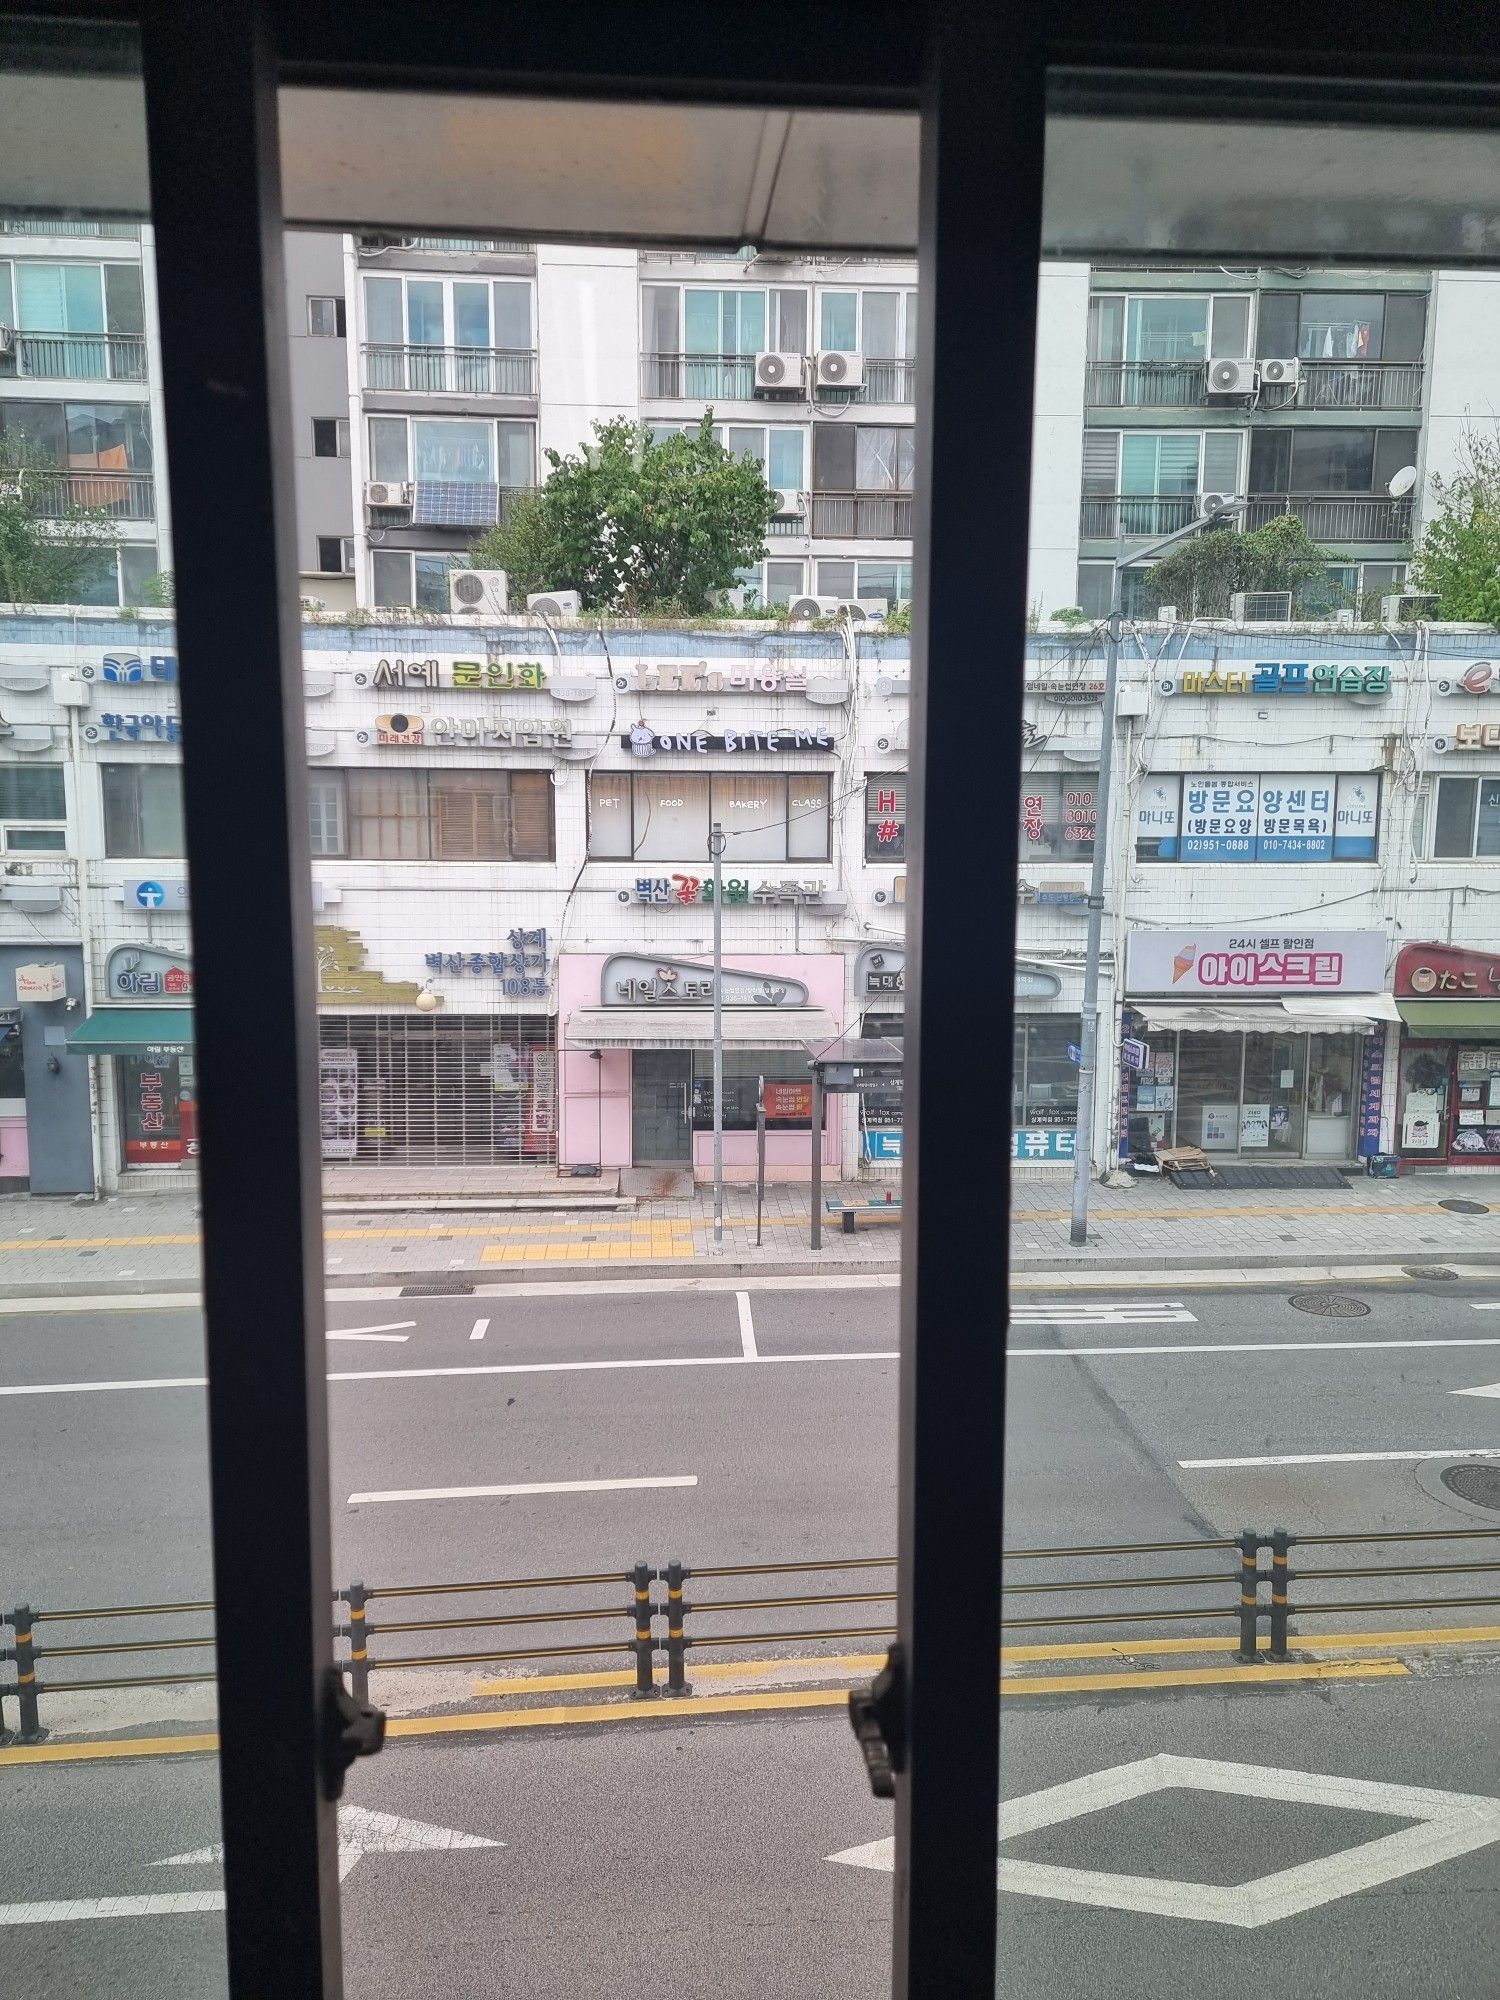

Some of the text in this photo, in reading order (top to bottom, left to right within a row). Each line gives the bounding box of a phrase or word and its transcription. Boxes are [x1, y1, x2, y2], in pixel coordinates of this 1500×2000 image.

[373, 659, 547, 689] 서예 문인화
[1183, 663, 1391, 694] 마스터 골프 연습장
[659, 727, 829, 753] ONE BITE ME
[599, 798, 620, 808] PET
[660, 799, 684, 808] FOOD
[729, 798, 768, 810] BAKERY
[791, 799, 822, 808] CLASS
[1067, 791, 1092, 806] 010
[1139, 810, 1175, 825] 마니또
[1337, 810, 1373, 825] 마니또
[1187, 839, 1249, 850] 02)951-0888
[1263, 839, 1326, 850] 010-7434-8802
[506, 928, 547, 952] 상계
[1229, 938, 1315, 950] 24시 셀프 할인점
[424, 952, 551, 975] 벽산종합상가
[1198, 952, 1342, 986] 아이스크림
[116, 972, 160, 994] 아림
[500, 977, 550, 997] 108동
[140, 1073, 164, 1132] 부동산
